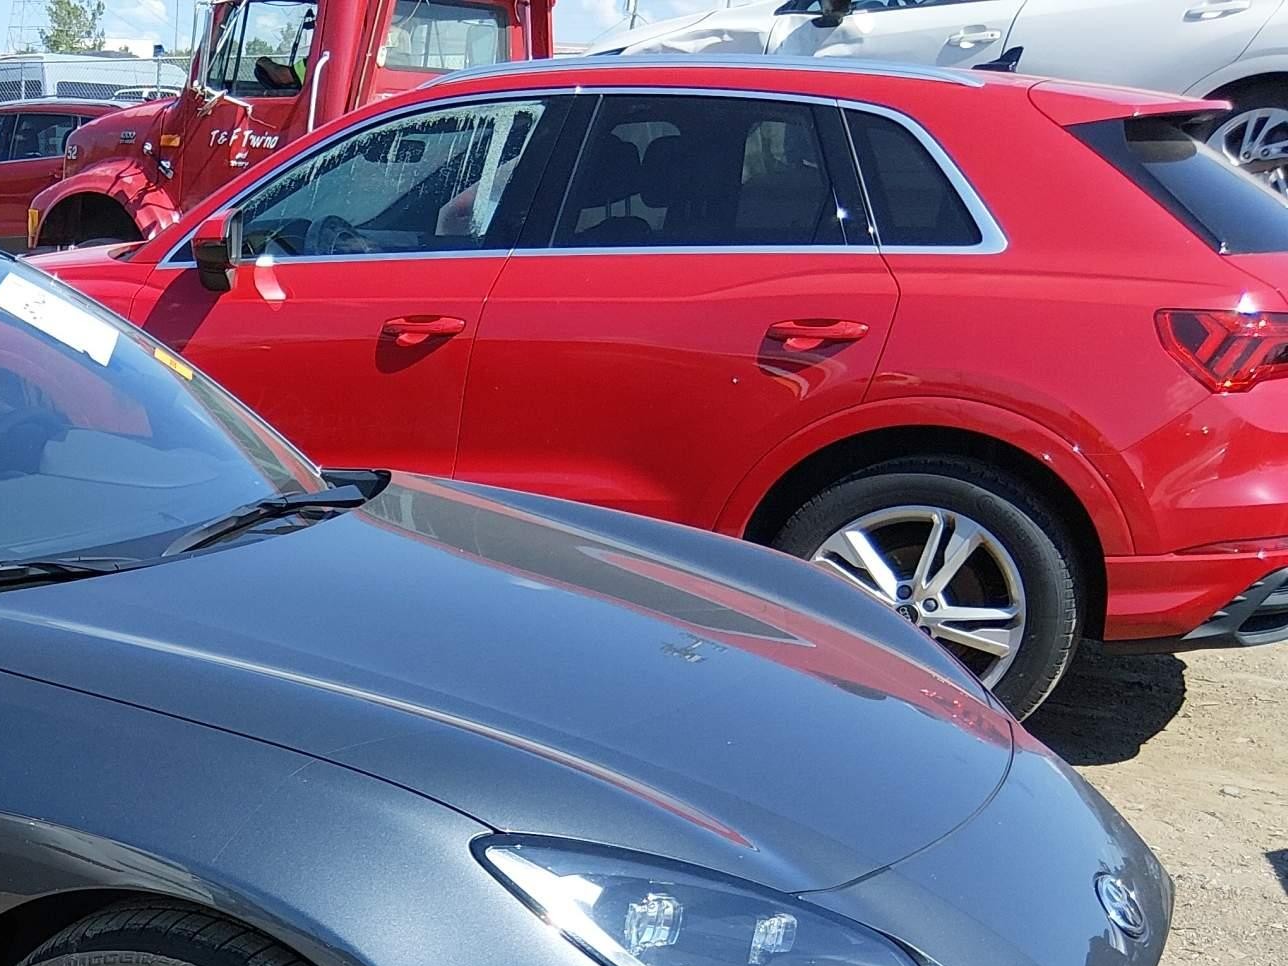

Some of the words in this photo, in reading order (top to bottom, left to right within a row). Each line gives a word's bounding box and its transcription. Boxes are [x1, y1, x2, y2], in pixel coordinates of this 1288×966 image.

[209, 129, 220, 147] T
[217, 131, 228, 145] &
[228, 127, 242, 147] F
